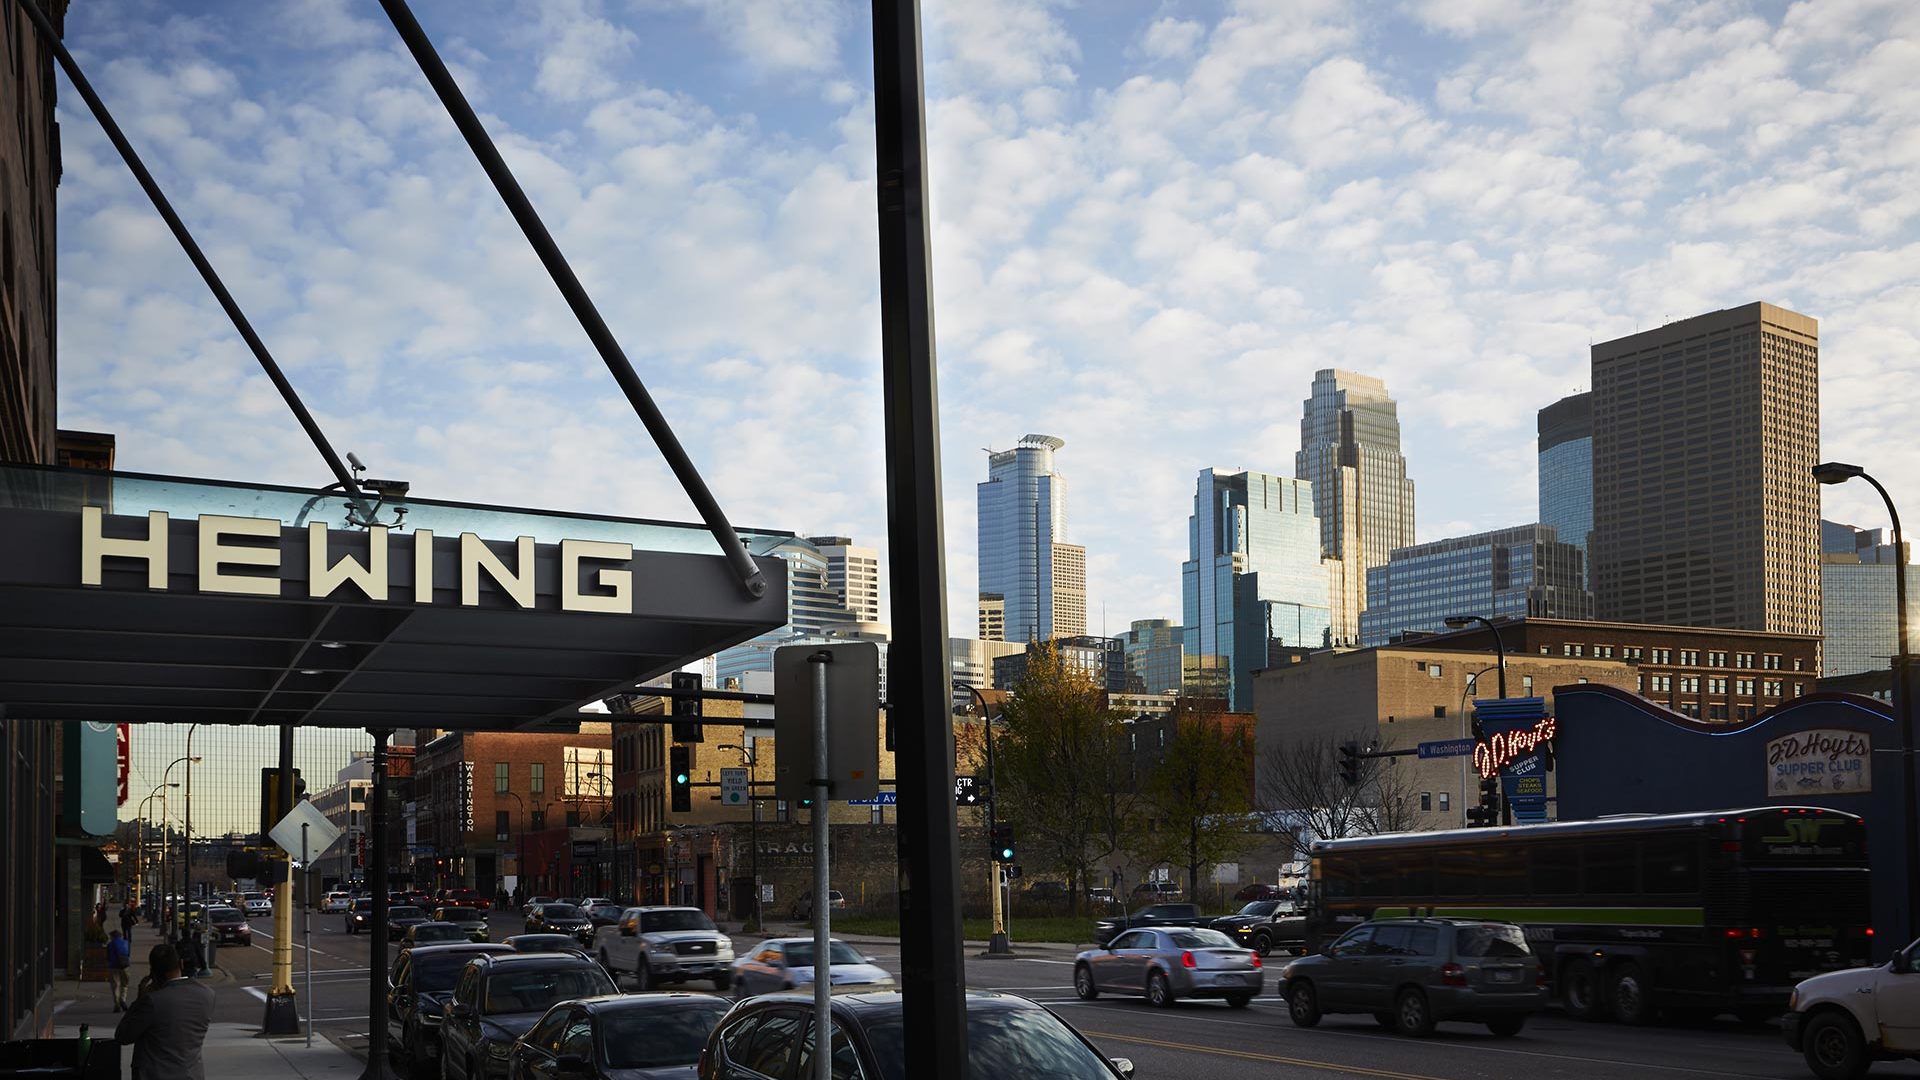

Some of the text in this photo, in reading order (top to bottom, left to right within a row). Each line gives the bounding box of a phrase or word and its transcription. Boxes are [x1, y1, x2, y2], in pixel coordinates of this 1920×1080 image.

[81, 505, 633, 614] HEWING
[1420, 744, 1471, 755] N Washington
[1509, 755, 1539, 773] SUPPER
[1516, 763, 1536, 776] CLUB
[1775, 758, 1862, 776] SUPPER CLUB
[957, 778, 973, 787] CTR
[465, 765, 475, 832] WASHINGTON
